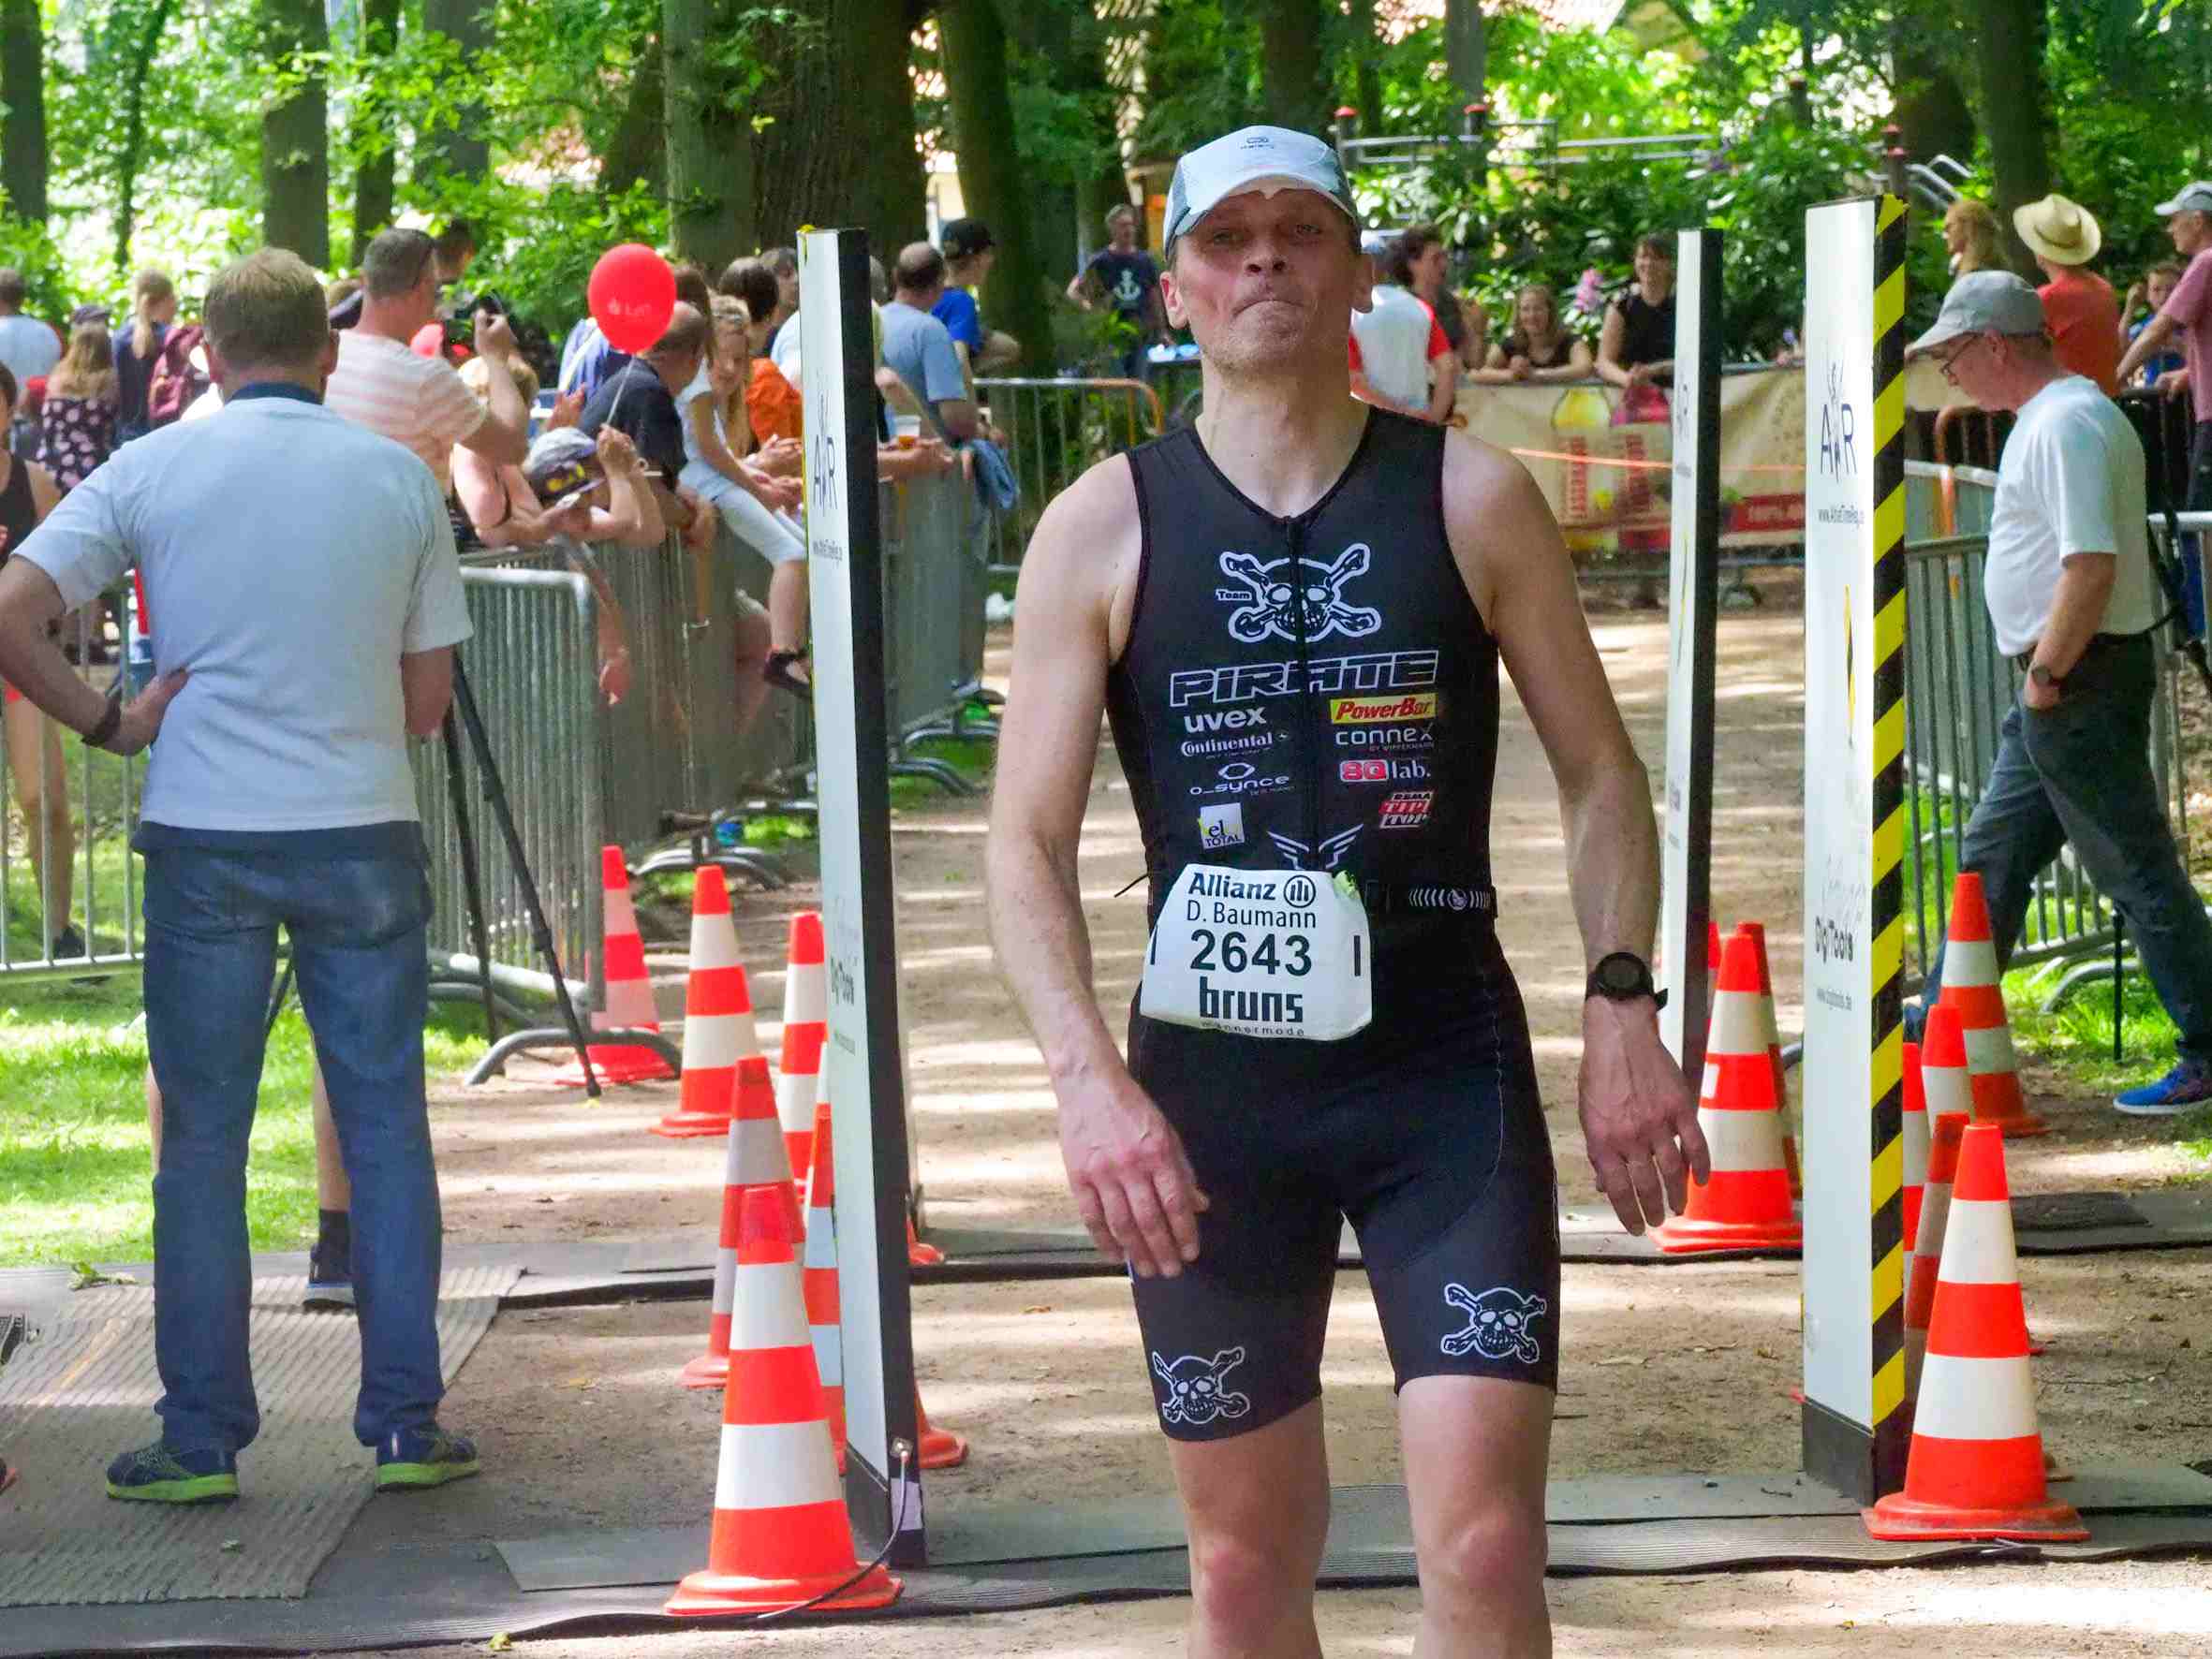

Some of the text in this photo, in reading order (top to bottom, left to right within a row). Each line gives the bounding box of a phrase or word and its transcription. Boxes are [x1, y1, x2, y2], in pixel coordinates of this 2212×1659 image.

[1217, 590, 1250, 600] Team
[1170, 650, 1439, 707] PIRATE
[1184, 707, 1266, 733] uvex
[1336, 697, 1432, 720] PowerBar
[1181, 732, 1273, 756] Continental
[1205, 834, 1239, 847] TOTAL
[1187, 872, 1276, 902] Allianz
[1187, 900, 1317, 929] D. Baumann
[1189, 929, 1312, 976] 2643
[1200, 976, 1303, 1023] bruns
